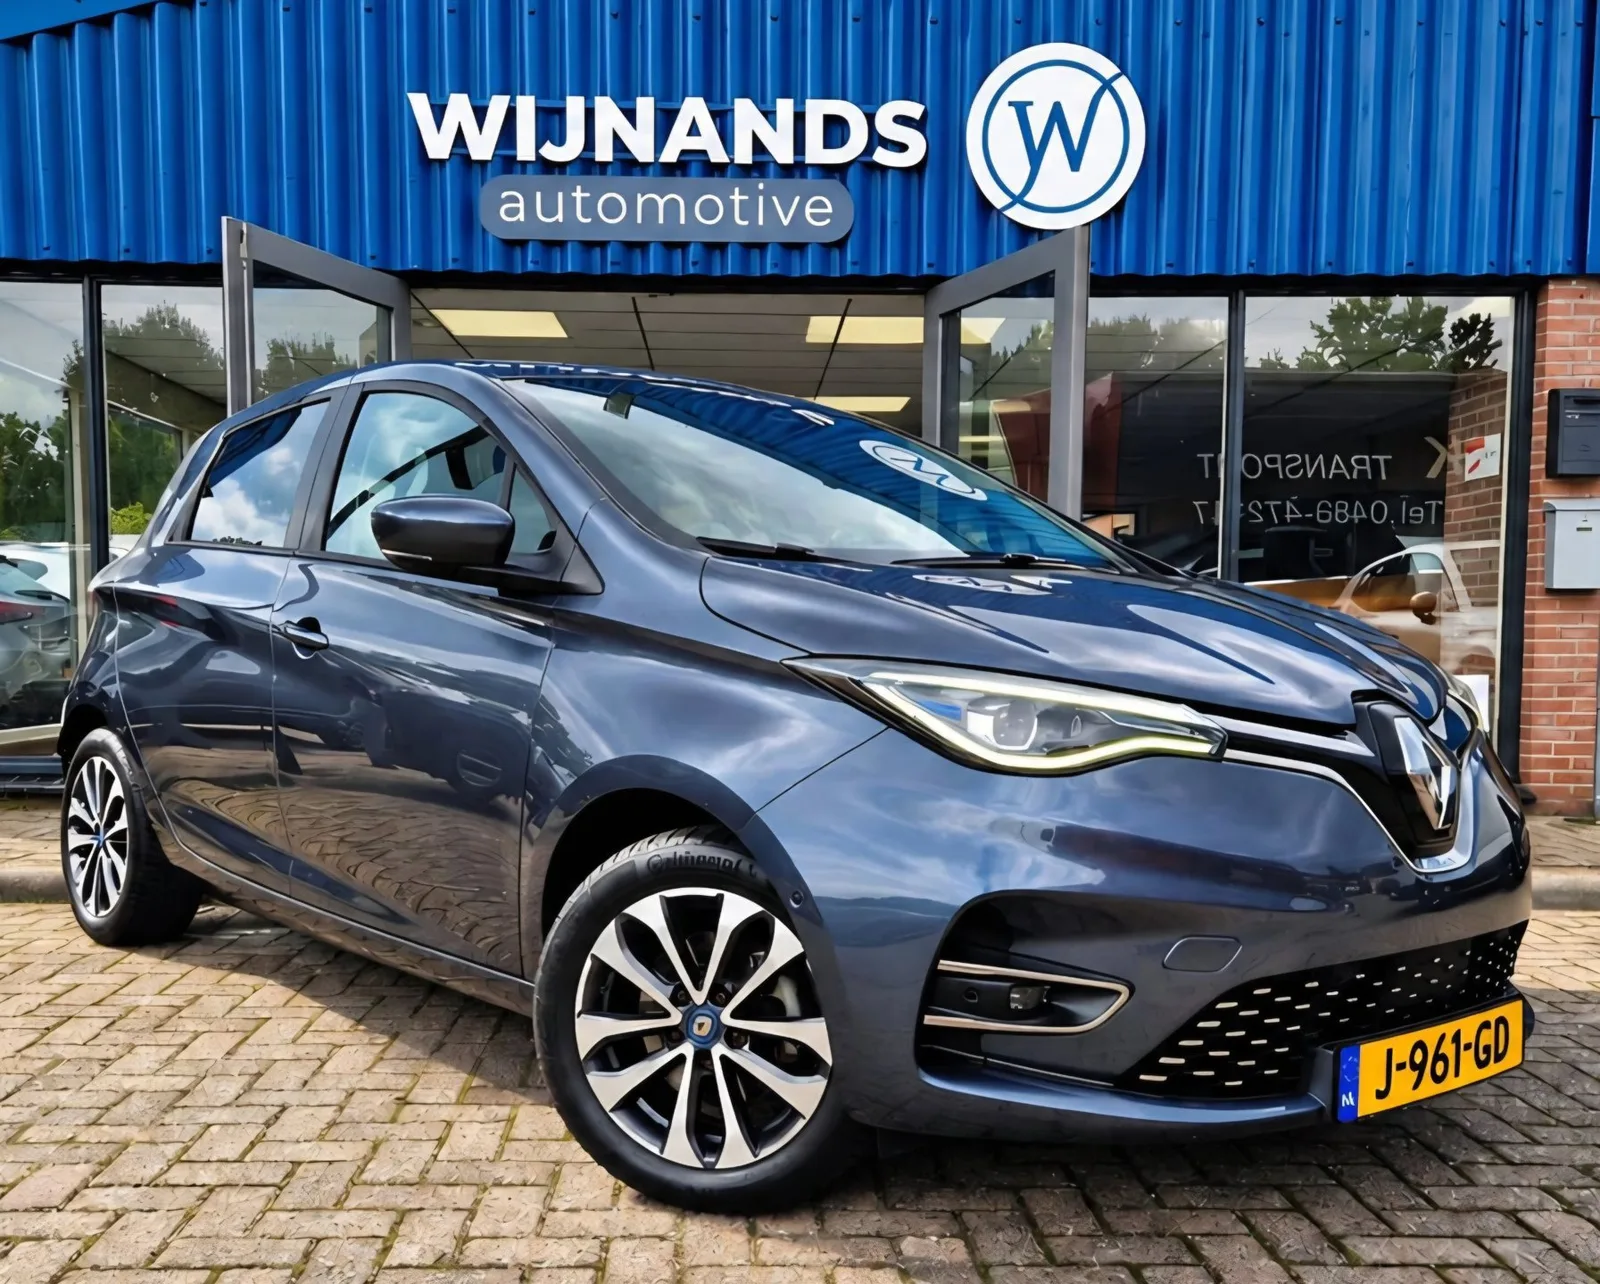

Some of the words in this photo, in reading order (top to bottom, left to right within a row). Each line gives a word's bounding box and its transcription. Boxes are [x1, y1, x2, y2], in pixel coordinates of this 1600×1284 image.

[408, 93, 927, 168] WIJNANDS
[498, 181, 834, 228] automotive
[1375, 1015, 1510, 1100] J-961-GD
